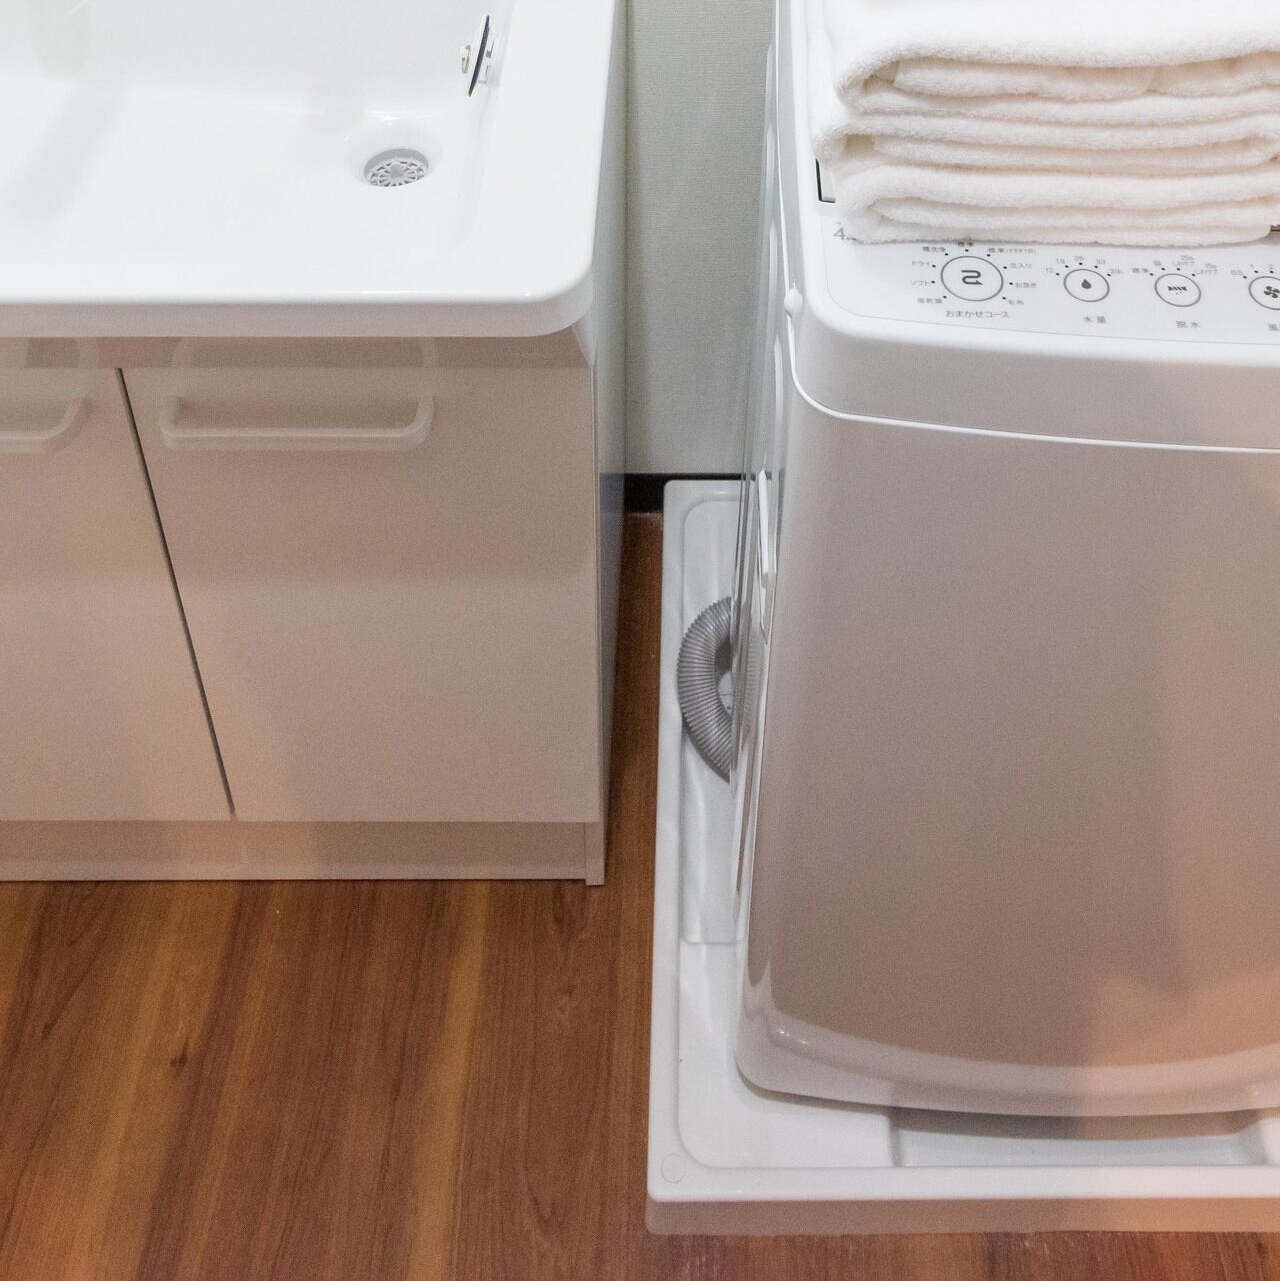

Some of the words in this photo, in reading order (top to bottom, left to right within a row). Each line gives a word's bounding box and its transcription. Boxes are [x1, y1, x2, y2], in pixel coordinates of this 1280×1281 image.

[945, 310, 1010, 319] おまかせコース
[1083, 316, 1106, 324] 水量
